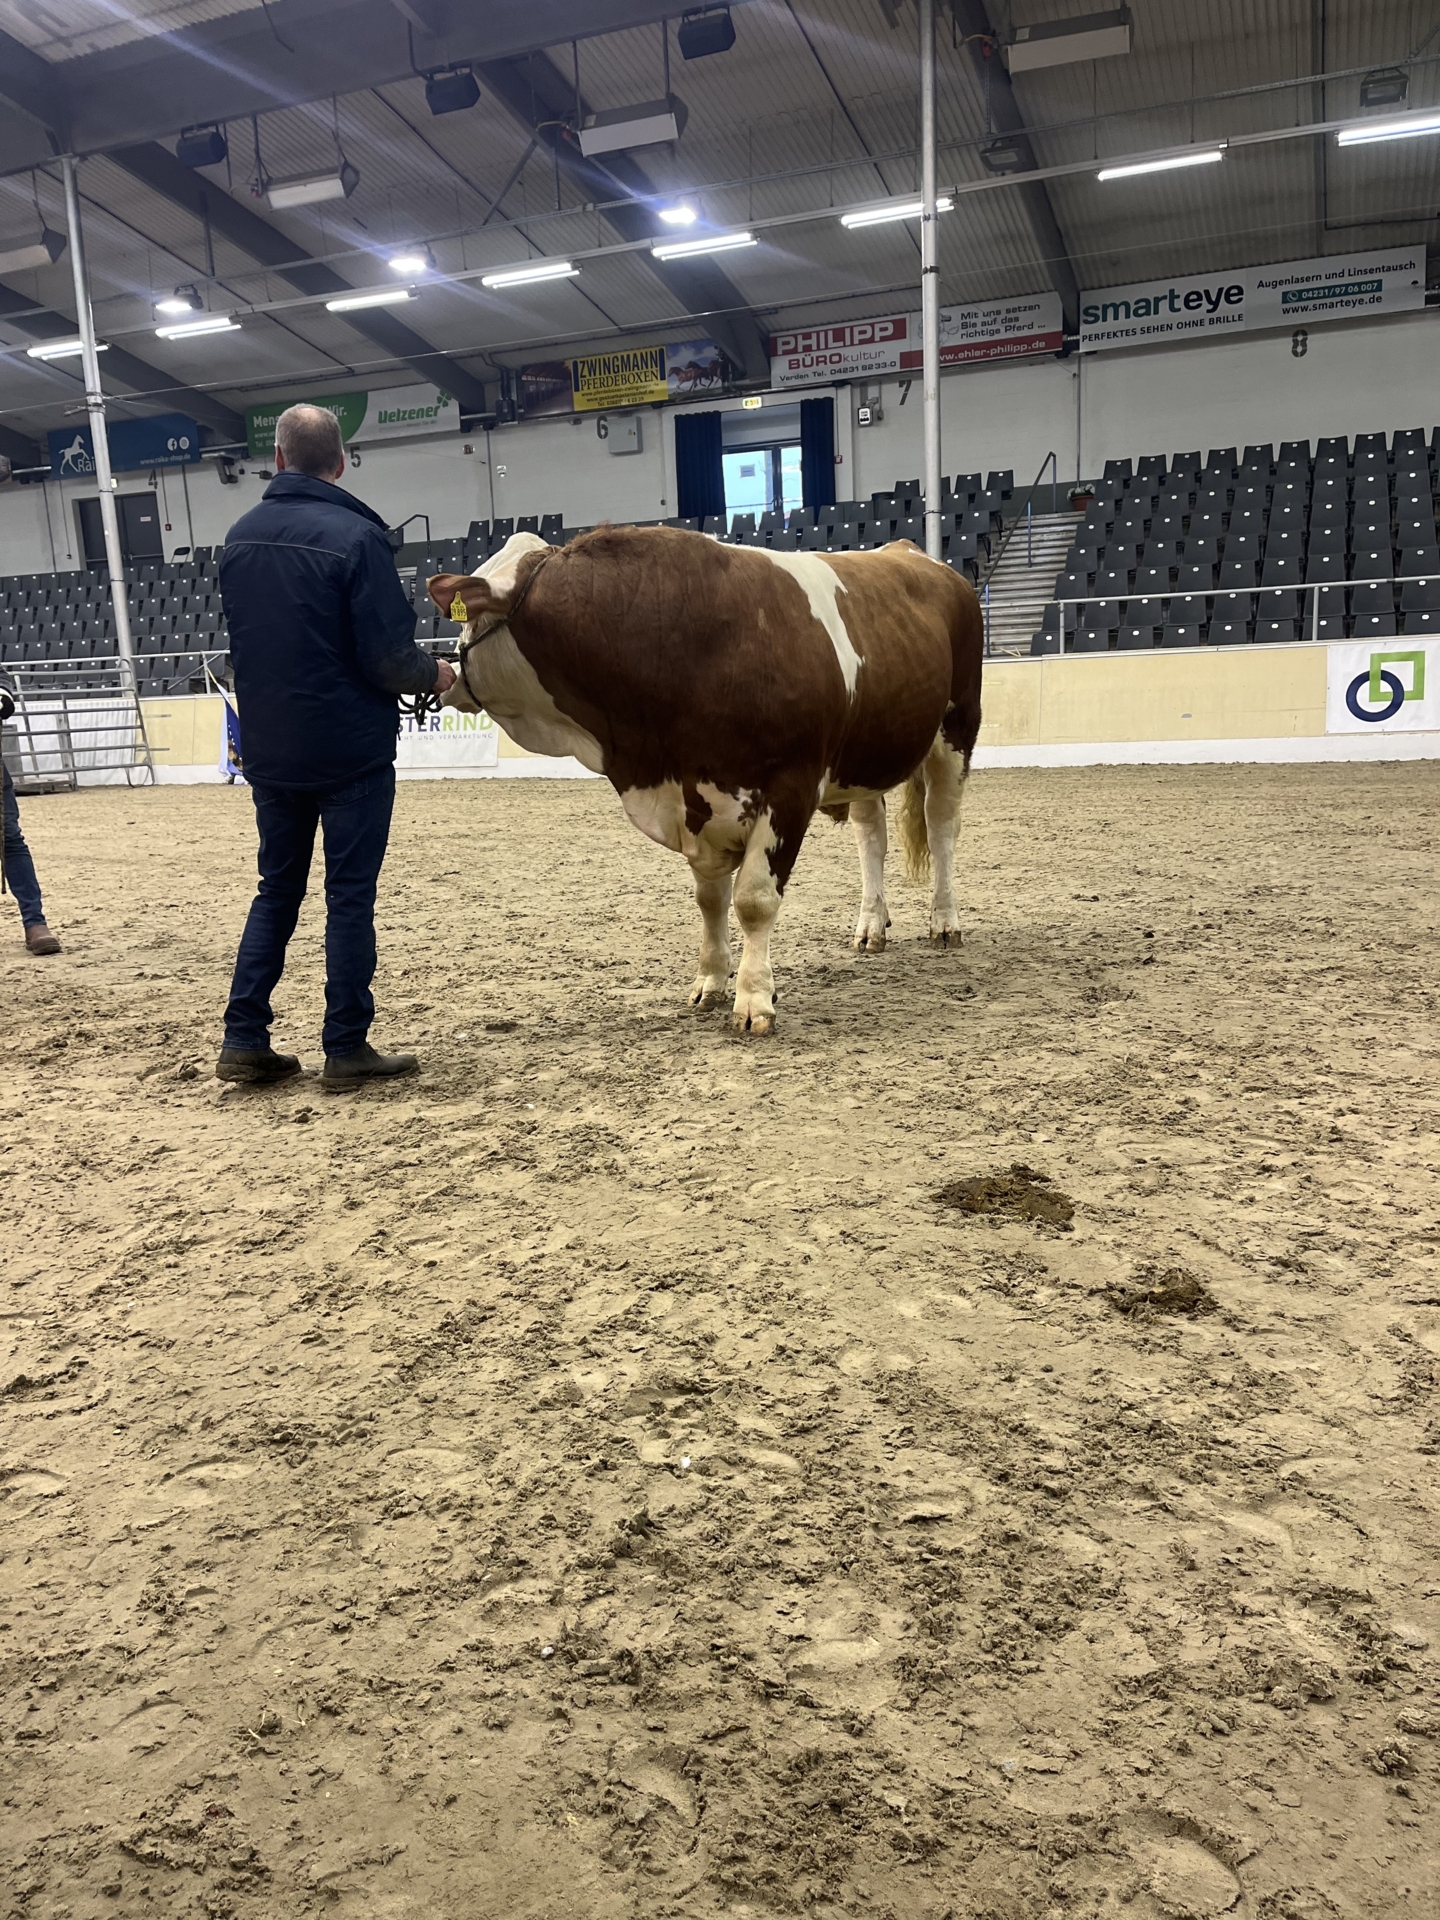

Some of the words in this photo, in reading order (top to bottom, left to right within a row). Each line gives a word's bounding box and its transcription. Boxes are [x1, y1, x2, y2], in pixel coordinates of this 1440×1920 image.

[1257, 273, 1322, 289] Augenlasern
[1325, 269, 1345, 280] und
[1348, 260, 1416, 277] Linsentausch
[1348, 284, 1359, 293] 06
[1361, 282, 1378, 292] 007
[961, 311, 979, 321] Mit
[982, 309, 1002, 318] uns
[1006, 304, 1041, 315] setzen
[1082, 284, 1245, 325] smarteye
[1282, 294, 1383, 315] www.smarteye.de
[961, 321, 977, 330] Sie
[981, 317, 998, 327] auf
[1001, 316, 1020, 325] das
[961, 328, 1001, 339] richtige
[1004, 322, 1034, 333] Pferd
[1081, 328, 1137, 343] PERFEKTES
[1140, 323, 1173, 335] SEHEN
[1176, 318, 1205, 330] OHNE
[1208, 313, 1244, 326] BRILLE
[776, 321, 894, 356] PHILIPP
[1291, 329, 1309, 358] 8
[940, 340, 1046, 361] ww.ehler-philipp.de
[579, 350, 659, 379] ZWINGMANN
[779, 373, 809, 382] Verden
[812, 370, 827, 378] Tel.
[830, 366, 859, 376] 04231
[580, 369, 659, 391] PFERDEBOXEN
[898, 380, 912, 406] 7
[378, 404, 441, 424] Uelzener
[596, 415, 608, 439] 6
[77, 457, 95, 473] Rai
[140, 453, 191, 465] www.raika-shop.de
[351, 446, 361, 468] 5
[148, 468, 158, 490] 4
